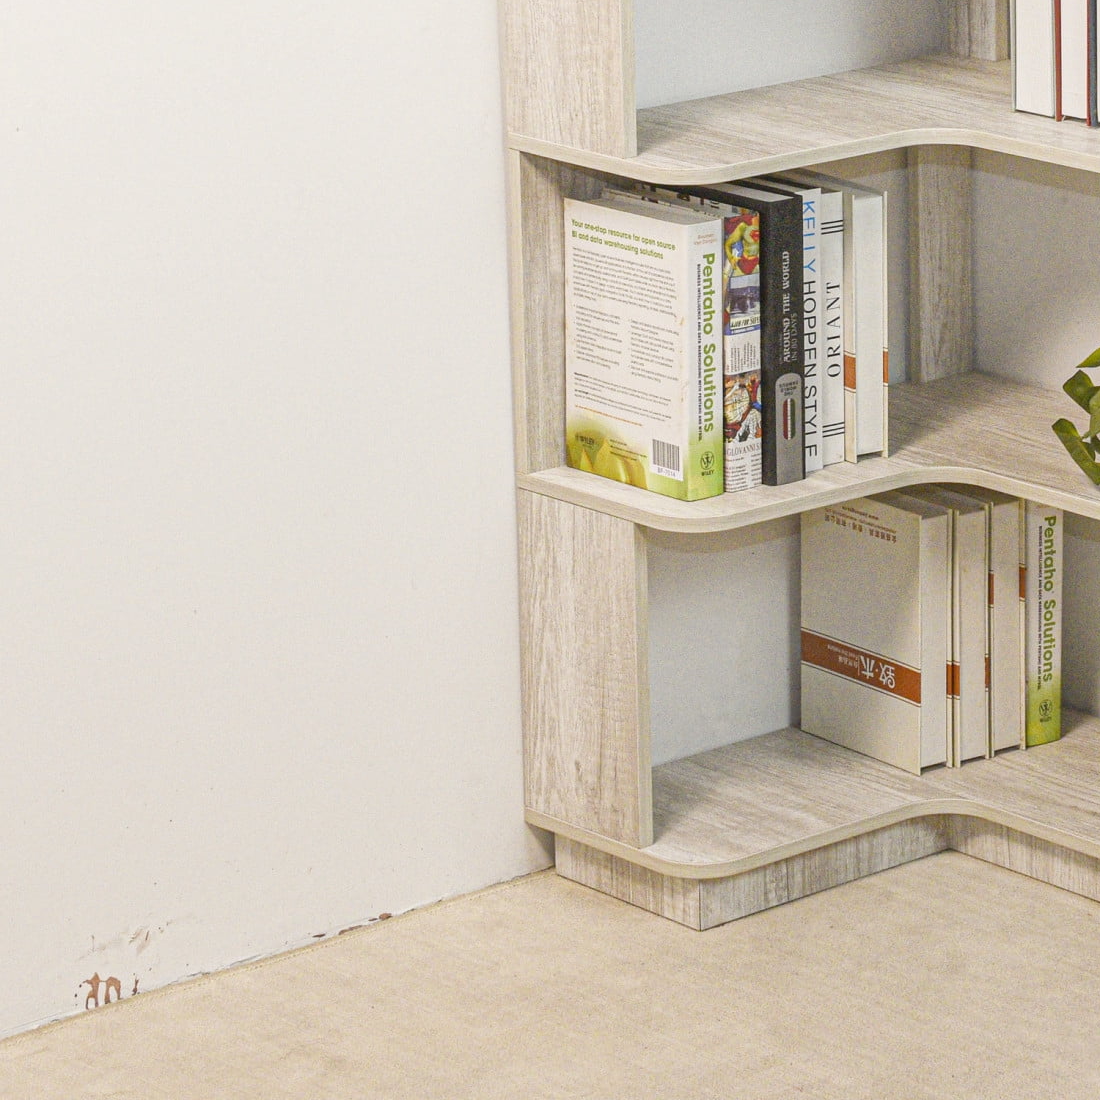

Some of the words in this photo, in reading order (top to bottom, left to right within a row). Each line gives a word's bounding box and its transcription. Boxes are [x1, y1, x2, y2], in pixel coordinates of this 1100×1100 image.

[571, 218, 583, 229] Your
[578, 232, 589, 241] and
[702, 252, 716, 335] Pentaho
[782, 251, 790, 290] WORLD
[782, 293, 790, 314] THE
[782, 317, 791, 362] AROUND
[803, 280, 817, 378] HOPPEN
[826, 282, 841, 378] ORIANT
[703, 343, 716, 433] Solutions
[1043, 515, 1057, 592] Pentaho
[1043, 599, 1056, 682] Solutions
